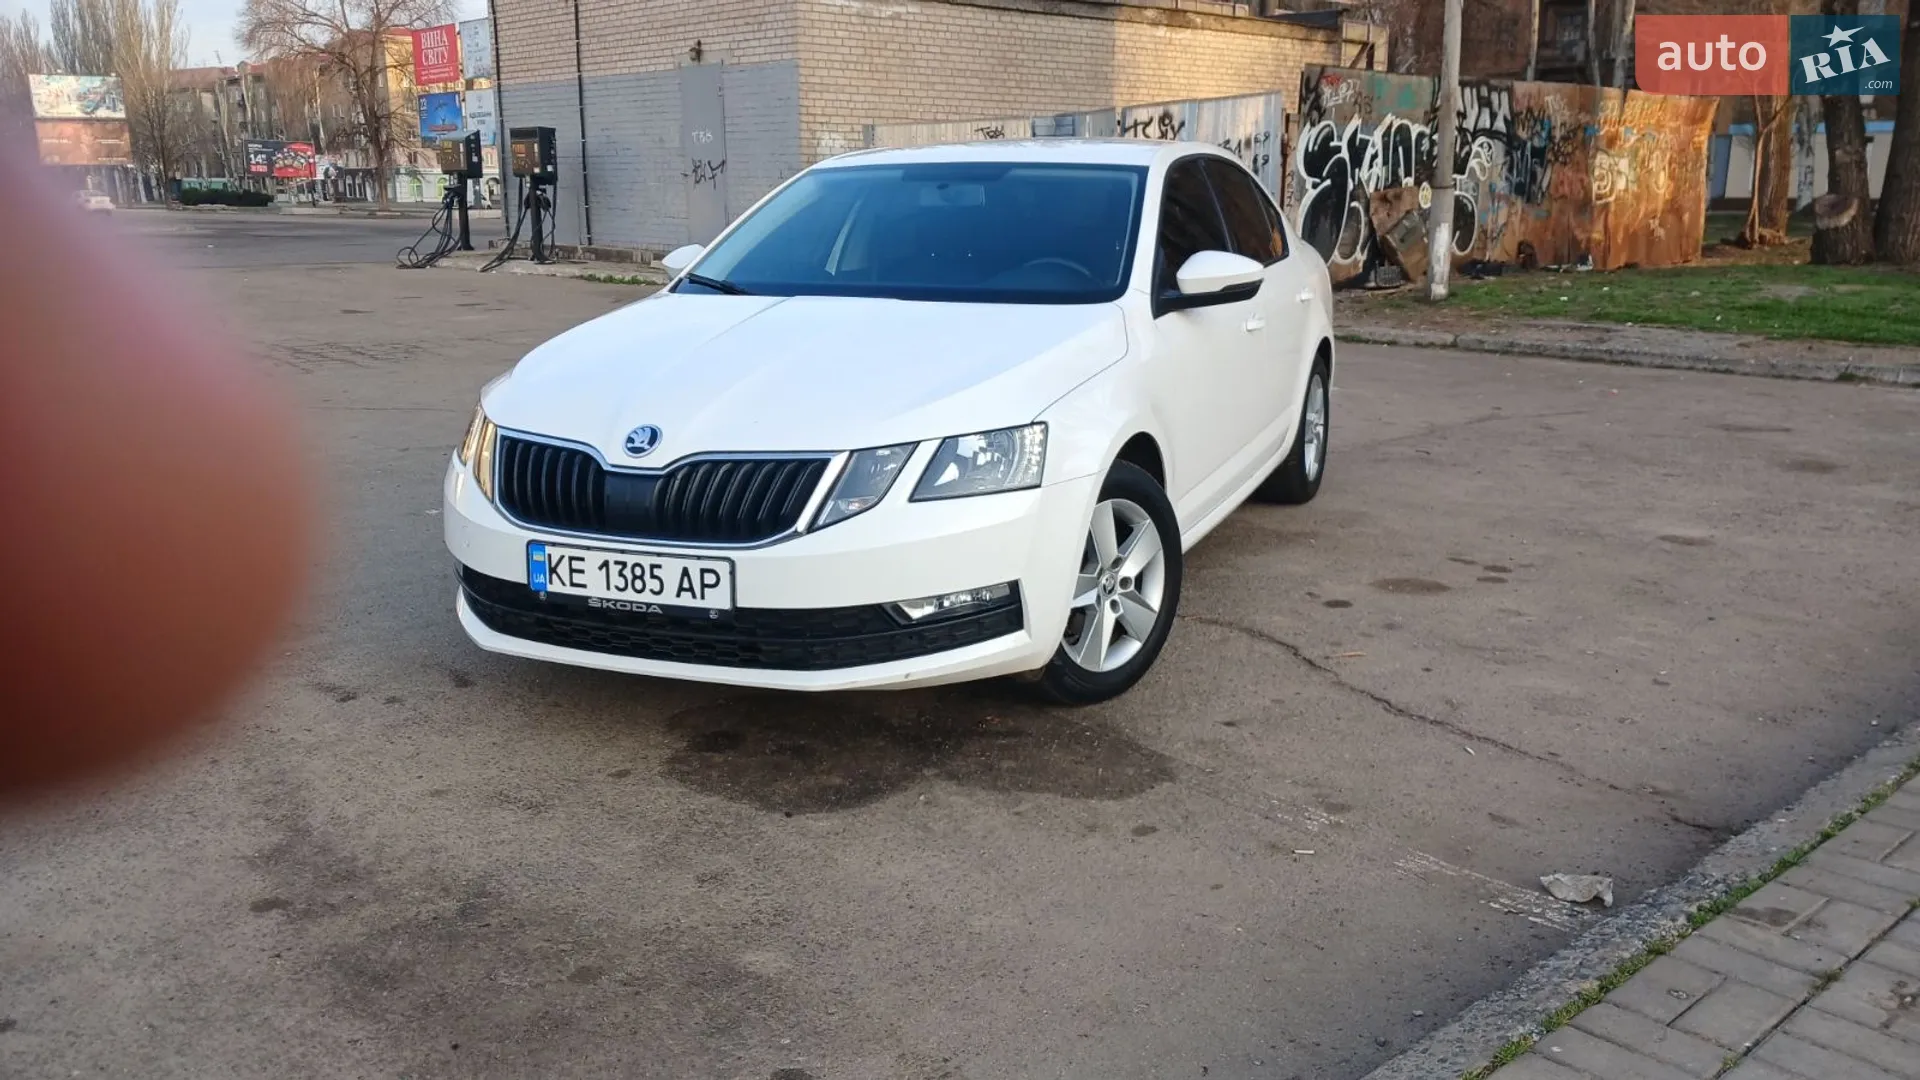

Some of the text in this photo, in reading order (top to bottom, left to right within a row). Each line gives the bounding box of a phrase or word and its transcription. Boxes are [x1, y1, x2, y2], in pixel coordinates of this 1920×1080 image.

[422, 46, 449, 66] СВІТУ
[533, 573, 546, 583] UA
[547, 553, 721, 600] KE 1385 AP
